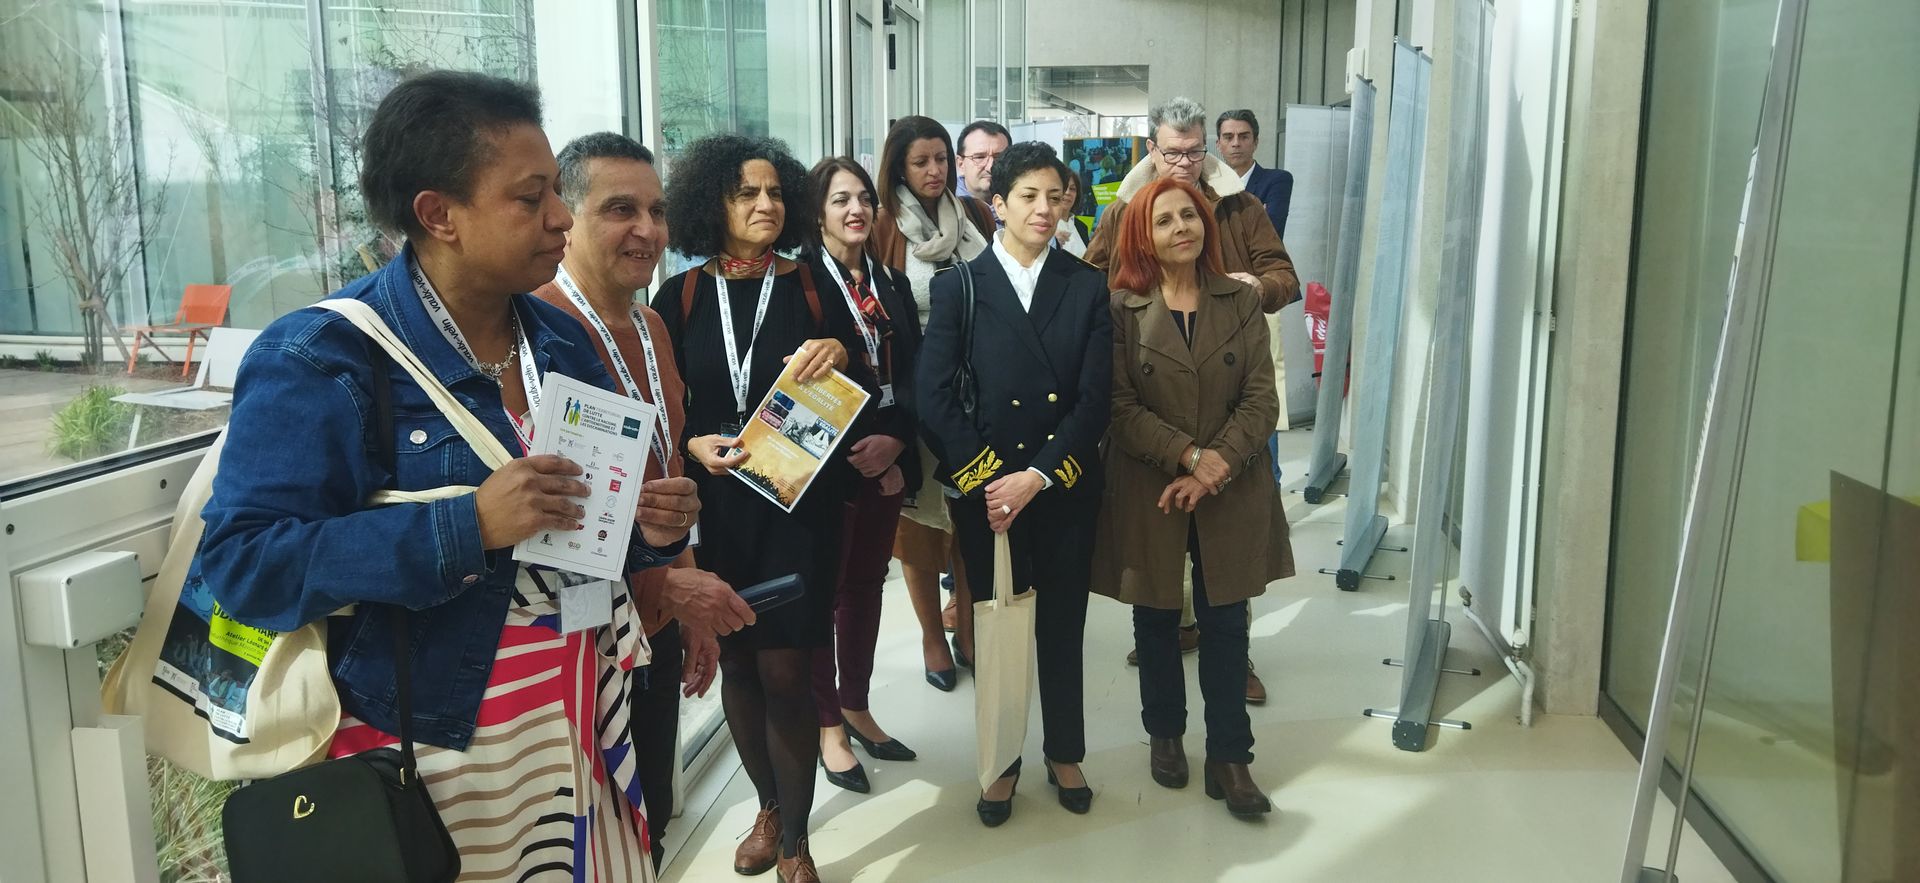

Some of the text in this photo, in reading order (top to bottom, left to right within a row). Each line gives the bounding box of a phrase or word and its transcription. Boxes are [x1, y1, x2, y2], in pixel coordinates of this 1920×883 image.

[410, 268, 441, 312] vaulx-velin
[442, 318, 474, 364] vaulx-velin
[588, 310, 612, 344] vaulx-velin
[633, 310, 649, 342] vaulx-velin
[612, 348, 632, 384] vaulx-velin
[526, 364, 540, 408] vaulx-velin
[226, 631, 246, 642] Atelier
